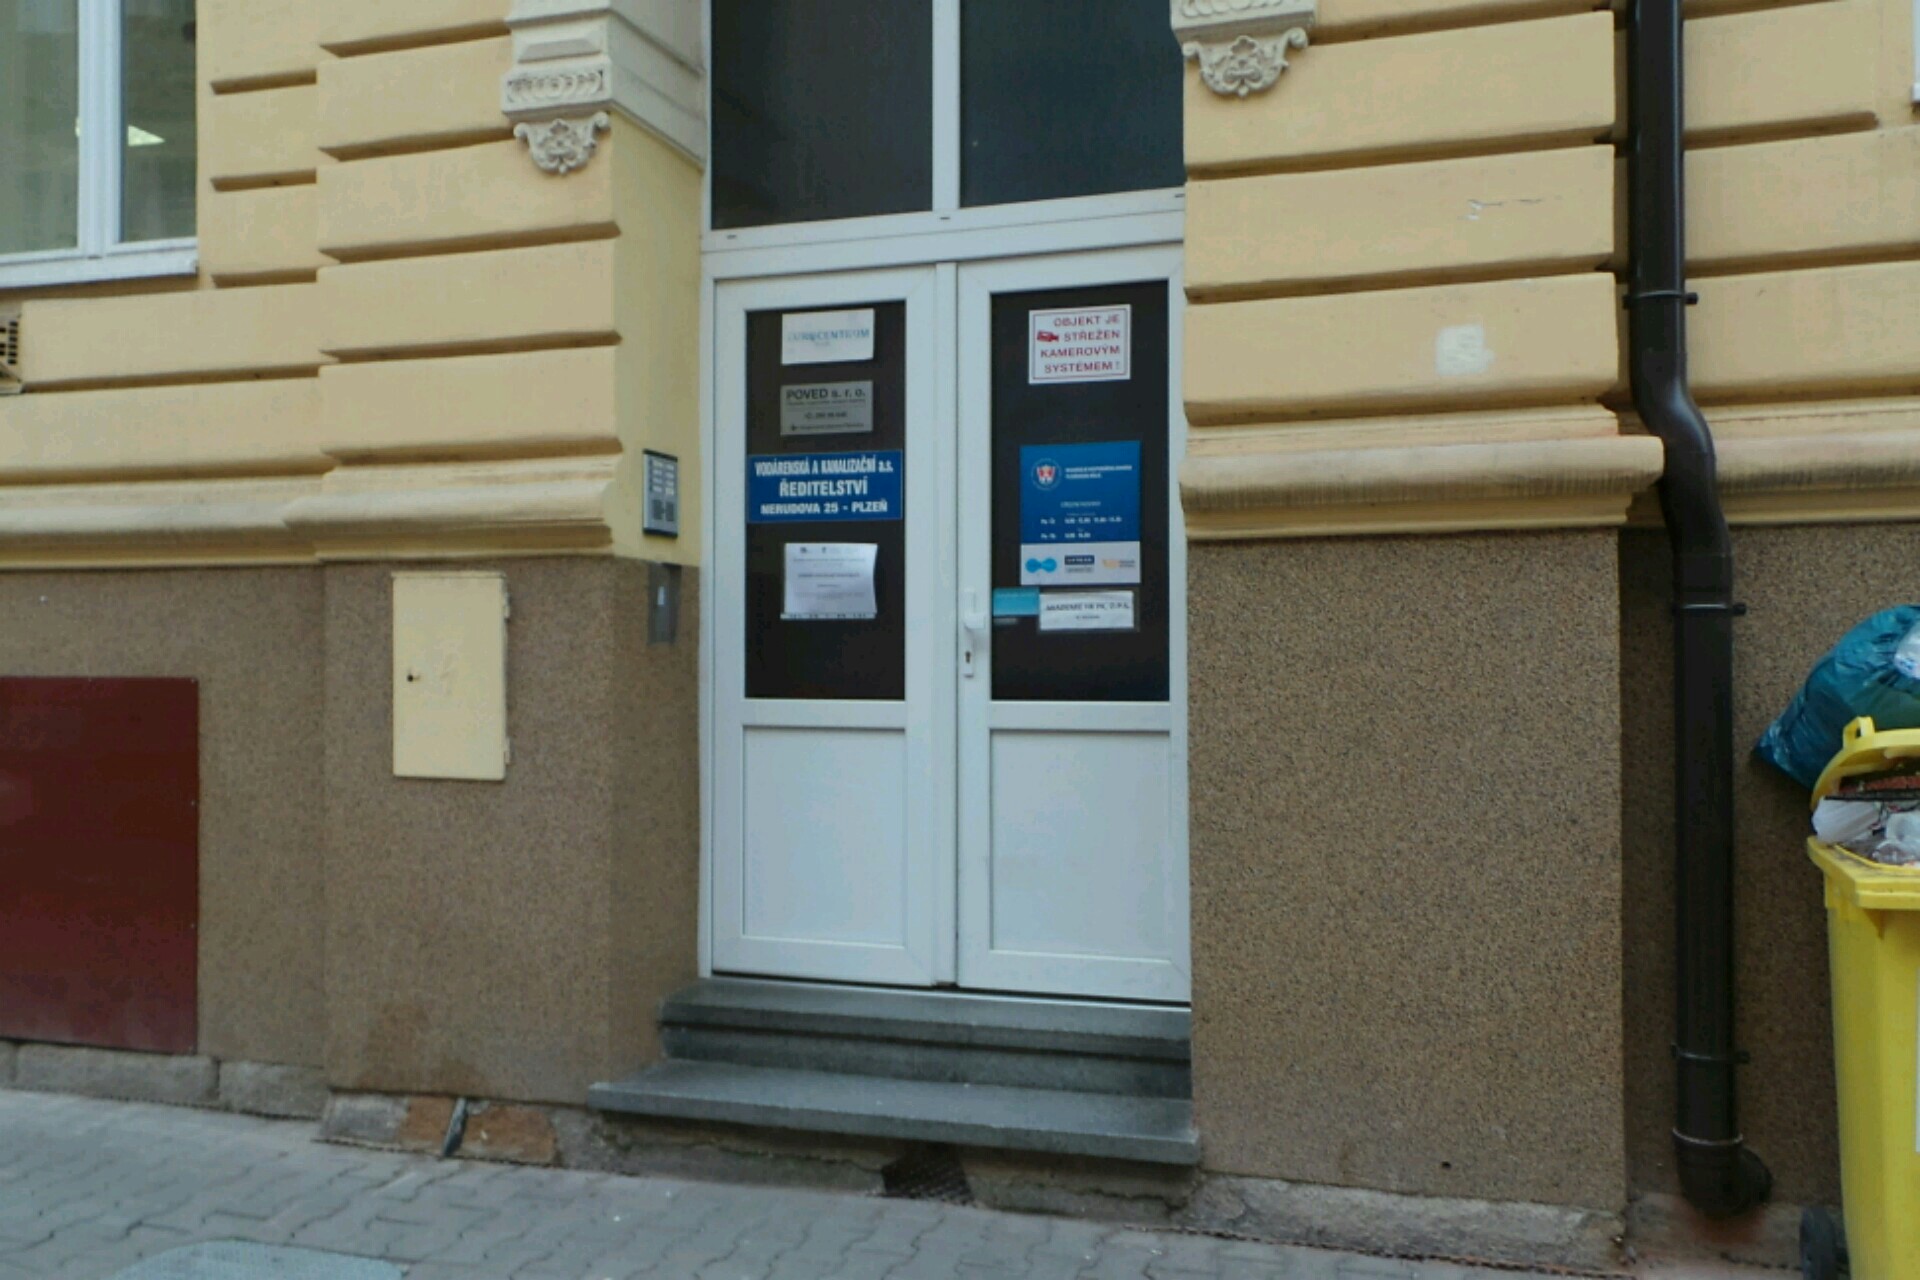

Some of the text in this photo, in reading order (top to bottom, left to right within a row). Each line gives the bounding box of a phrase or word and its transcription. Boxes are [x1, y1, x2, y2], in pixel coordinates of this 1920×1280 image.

[1054, 314, 1119, 327] OBJEKT JE
[1064, 328, 1120, 342] STŘEŽEN
[1040, 344, 1120, 358] KAMEROVÝM
[786, 388, 866, 400] POVED s. r. o.
[755, 455, 893, 476] VODÁRENSKÁ A KANALIZAČNÍ a.s.
[779, 476, 868, 497] ŘEDITELSTVÍ
[760, 502, 821, 515] NERUDOVA
[824, 502, 839, 514] 25
[852, 498, 888, 512] PLZEŇ
